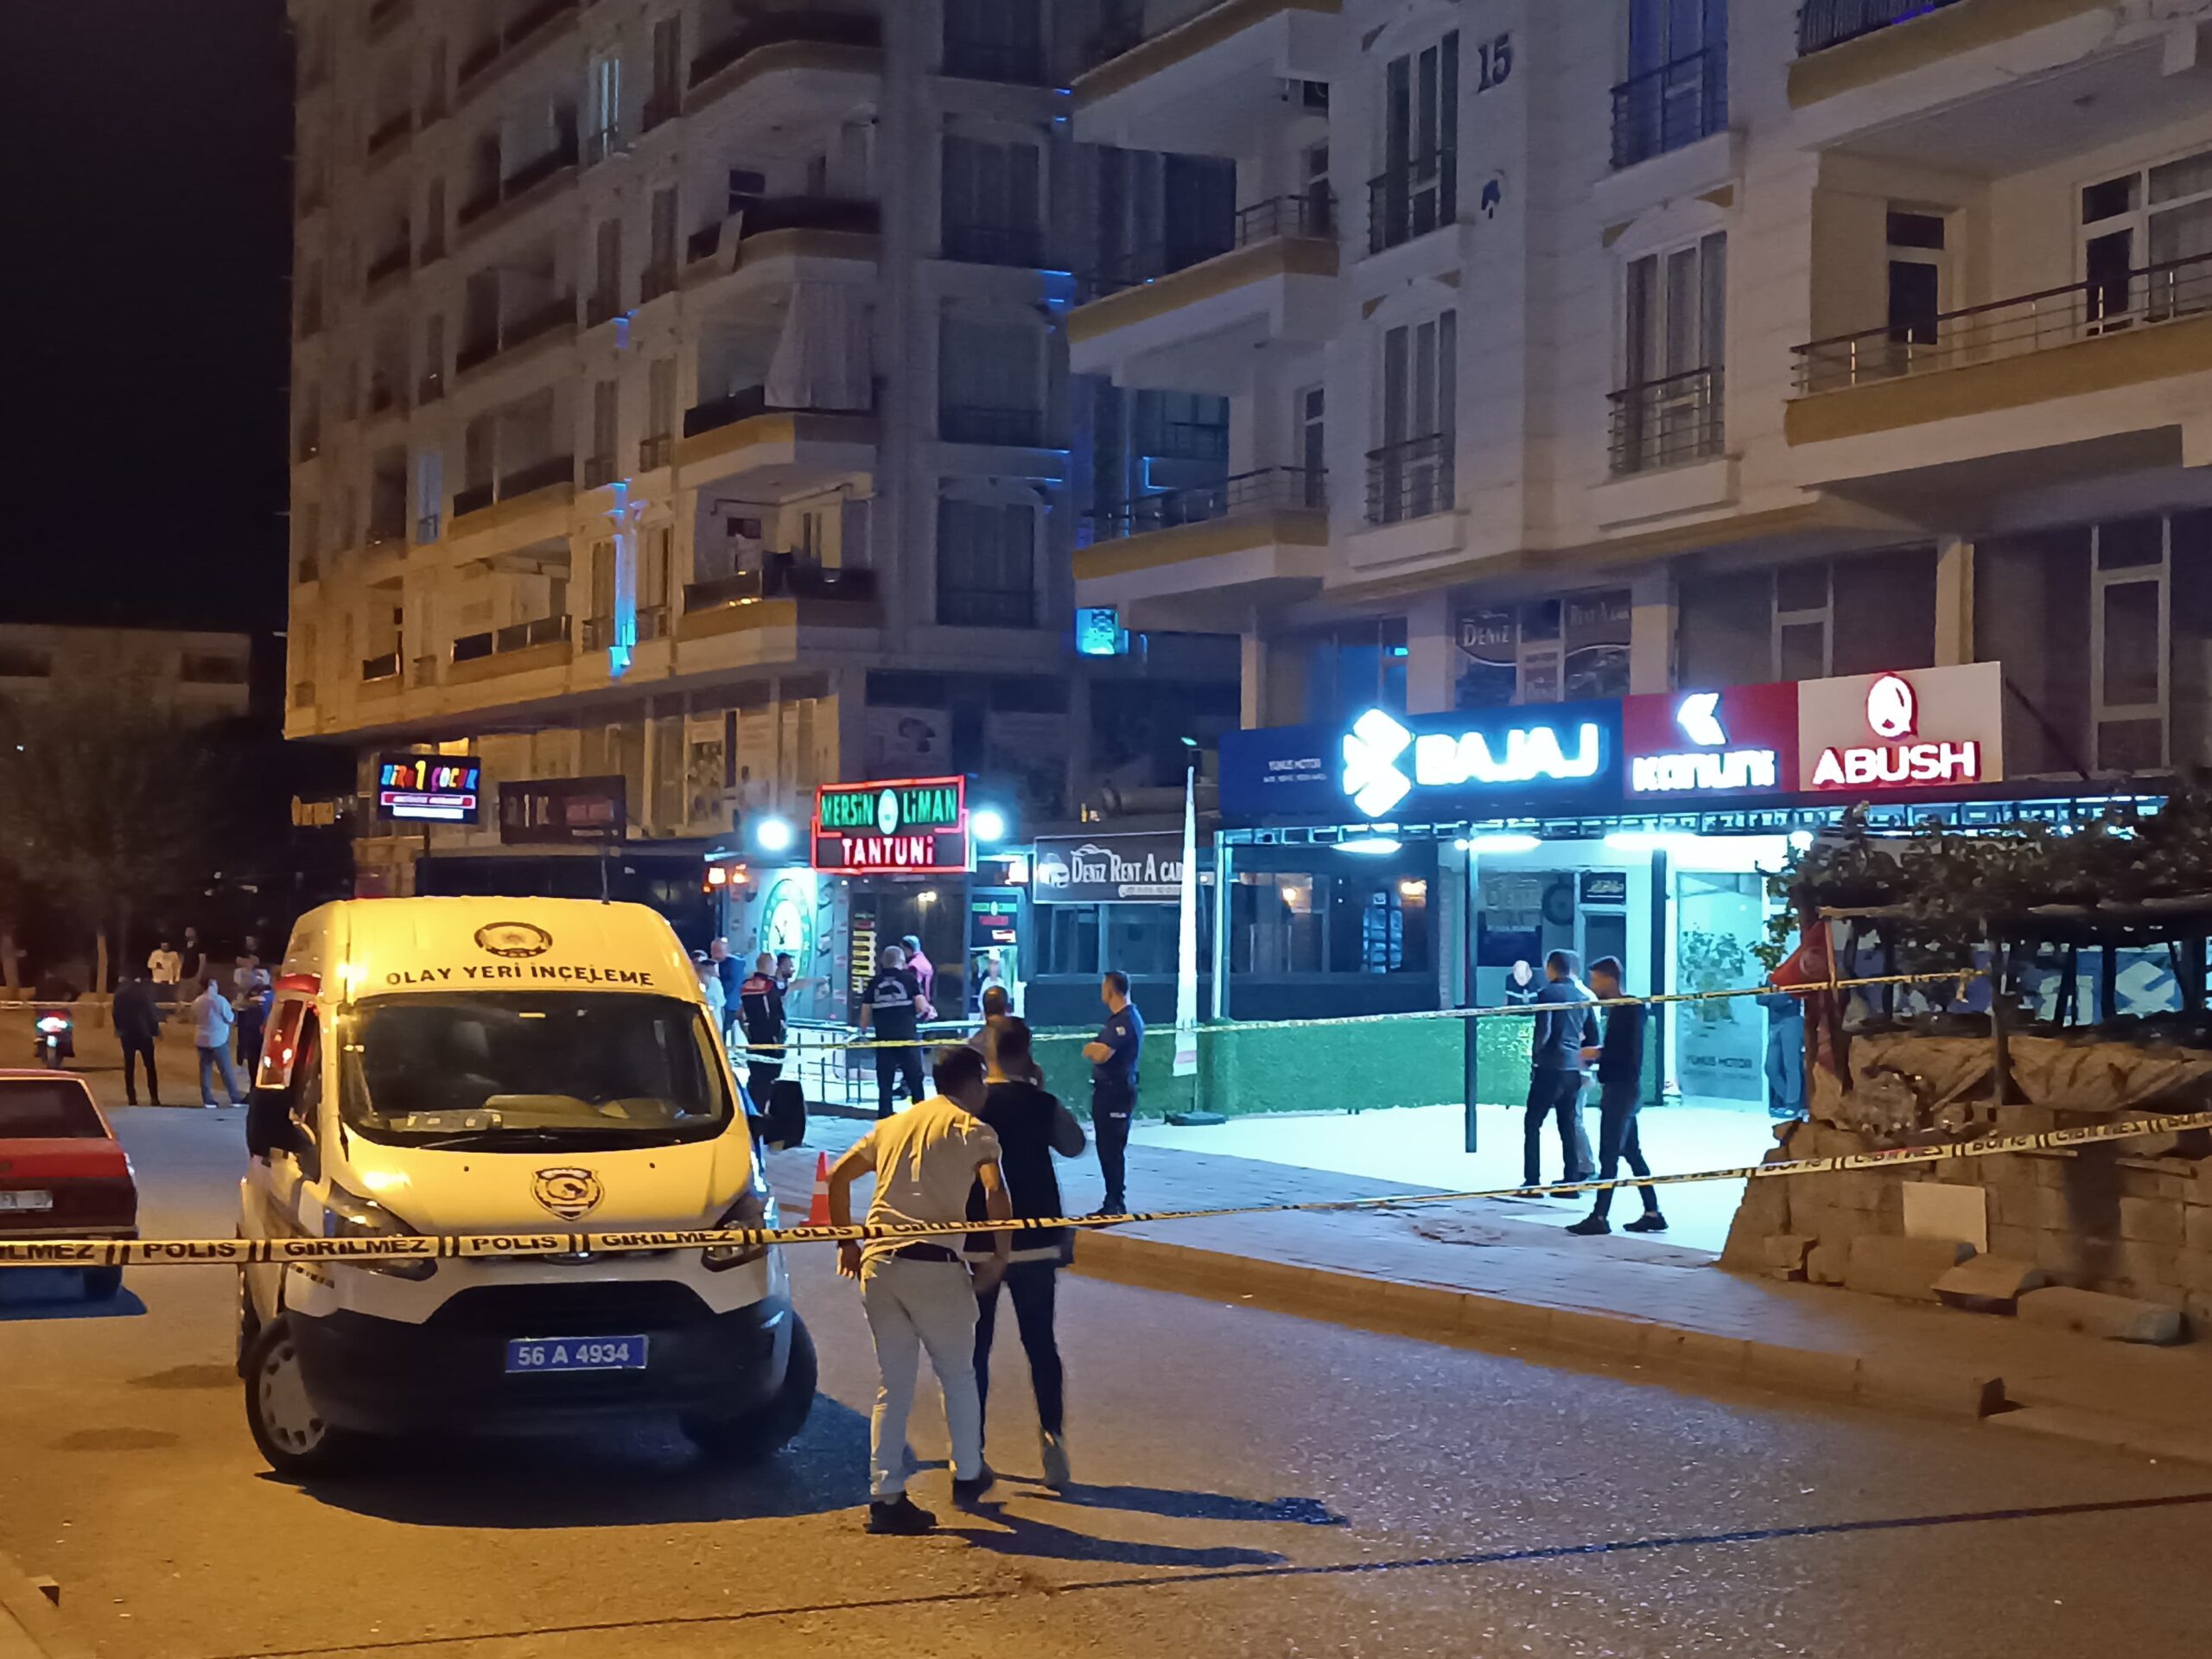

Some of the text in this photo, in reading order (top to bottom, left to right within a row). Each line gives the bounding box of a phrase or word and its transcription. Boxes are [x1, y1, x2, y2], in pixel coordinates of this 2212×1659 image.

[1477, 33, 1512, 93] 15
[1415, 722, 1599, 785] BAJAJ
[1813, 741, 1977, 786] ABUSH
[1144, 853, 1157, 882] A
[385, 967, 452, 985] OLAY
[518, 1343, 630, 1365] 56 A 4934
